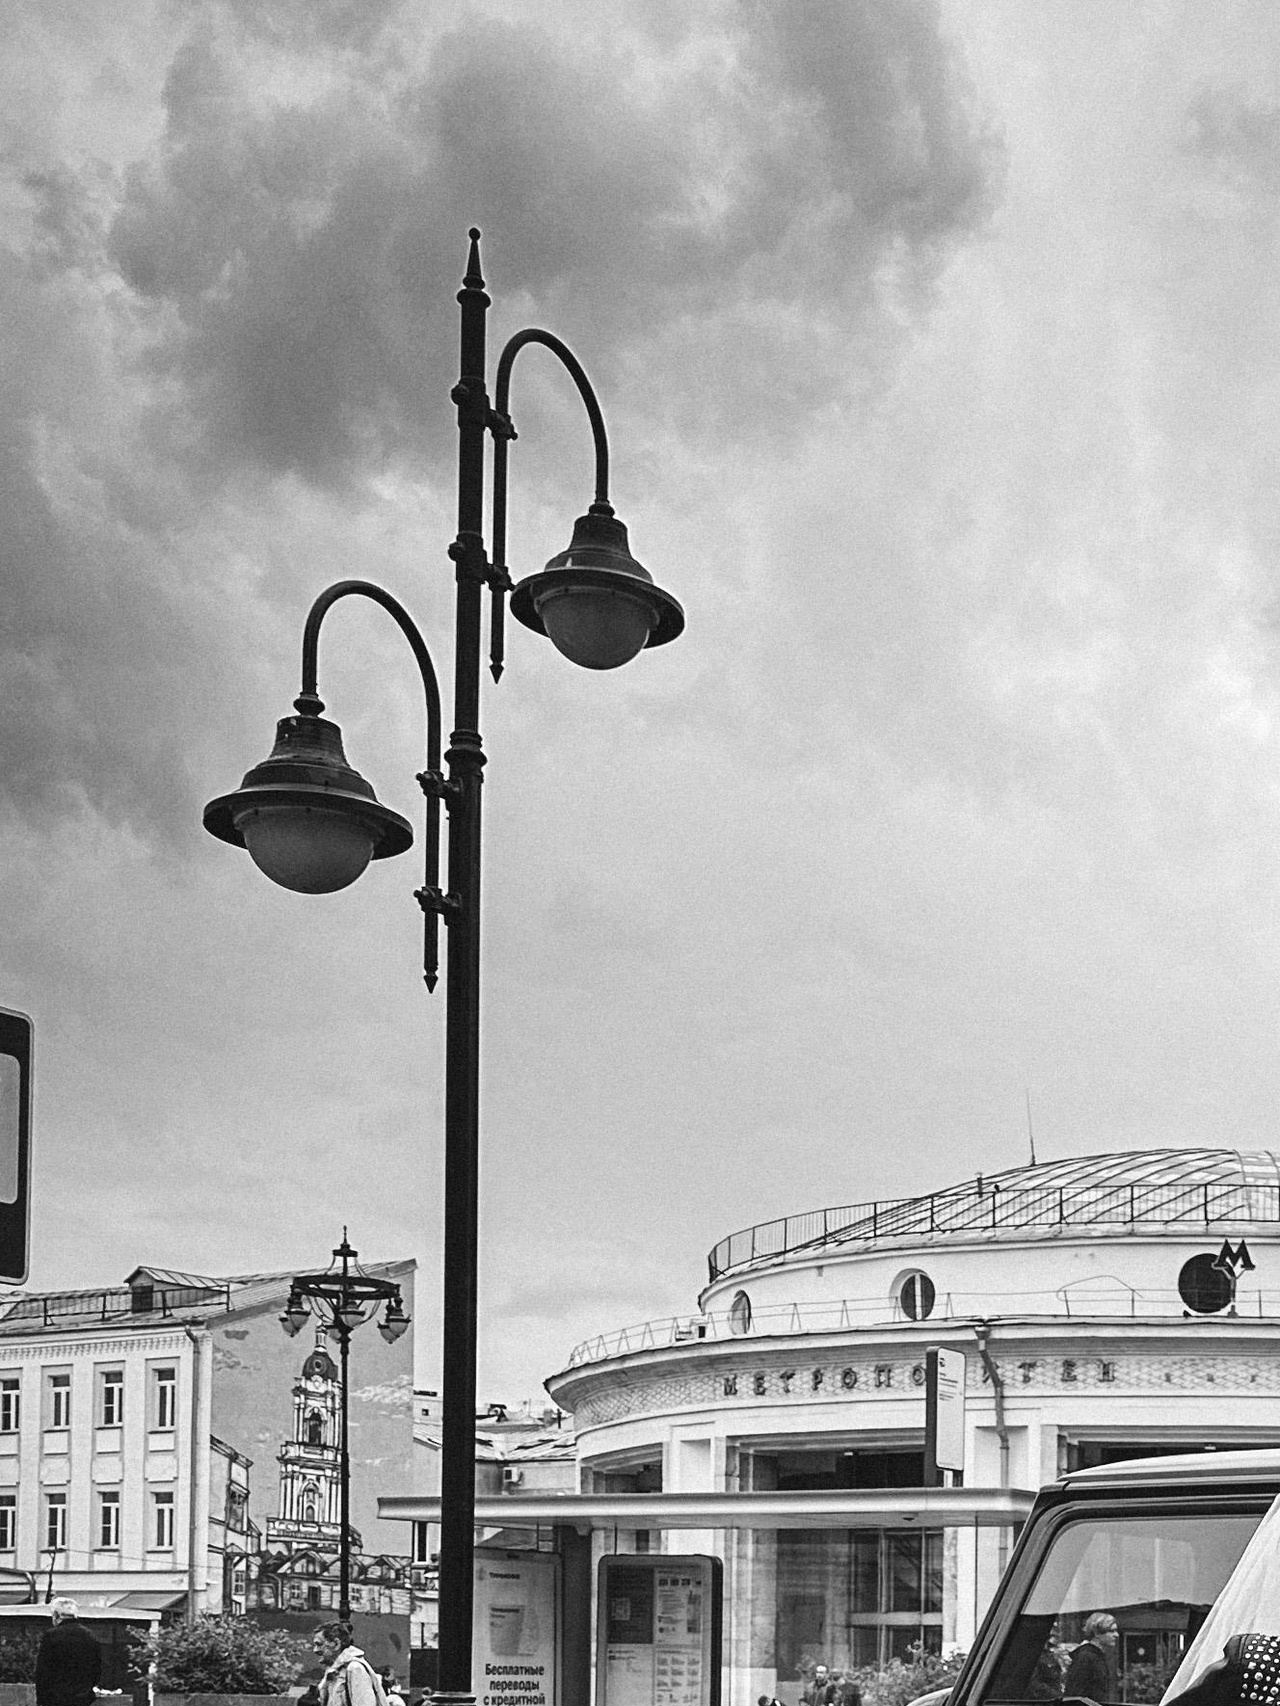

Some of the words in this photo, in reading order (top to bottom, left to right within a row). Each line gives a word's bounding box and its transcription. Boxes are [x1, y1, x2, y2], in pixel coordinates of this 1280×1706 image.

[485, 1663, 545, 1676] Бесплатные
[489, 1680, 540, 1693] переводы
[483, 1695, 490, 1706] с
